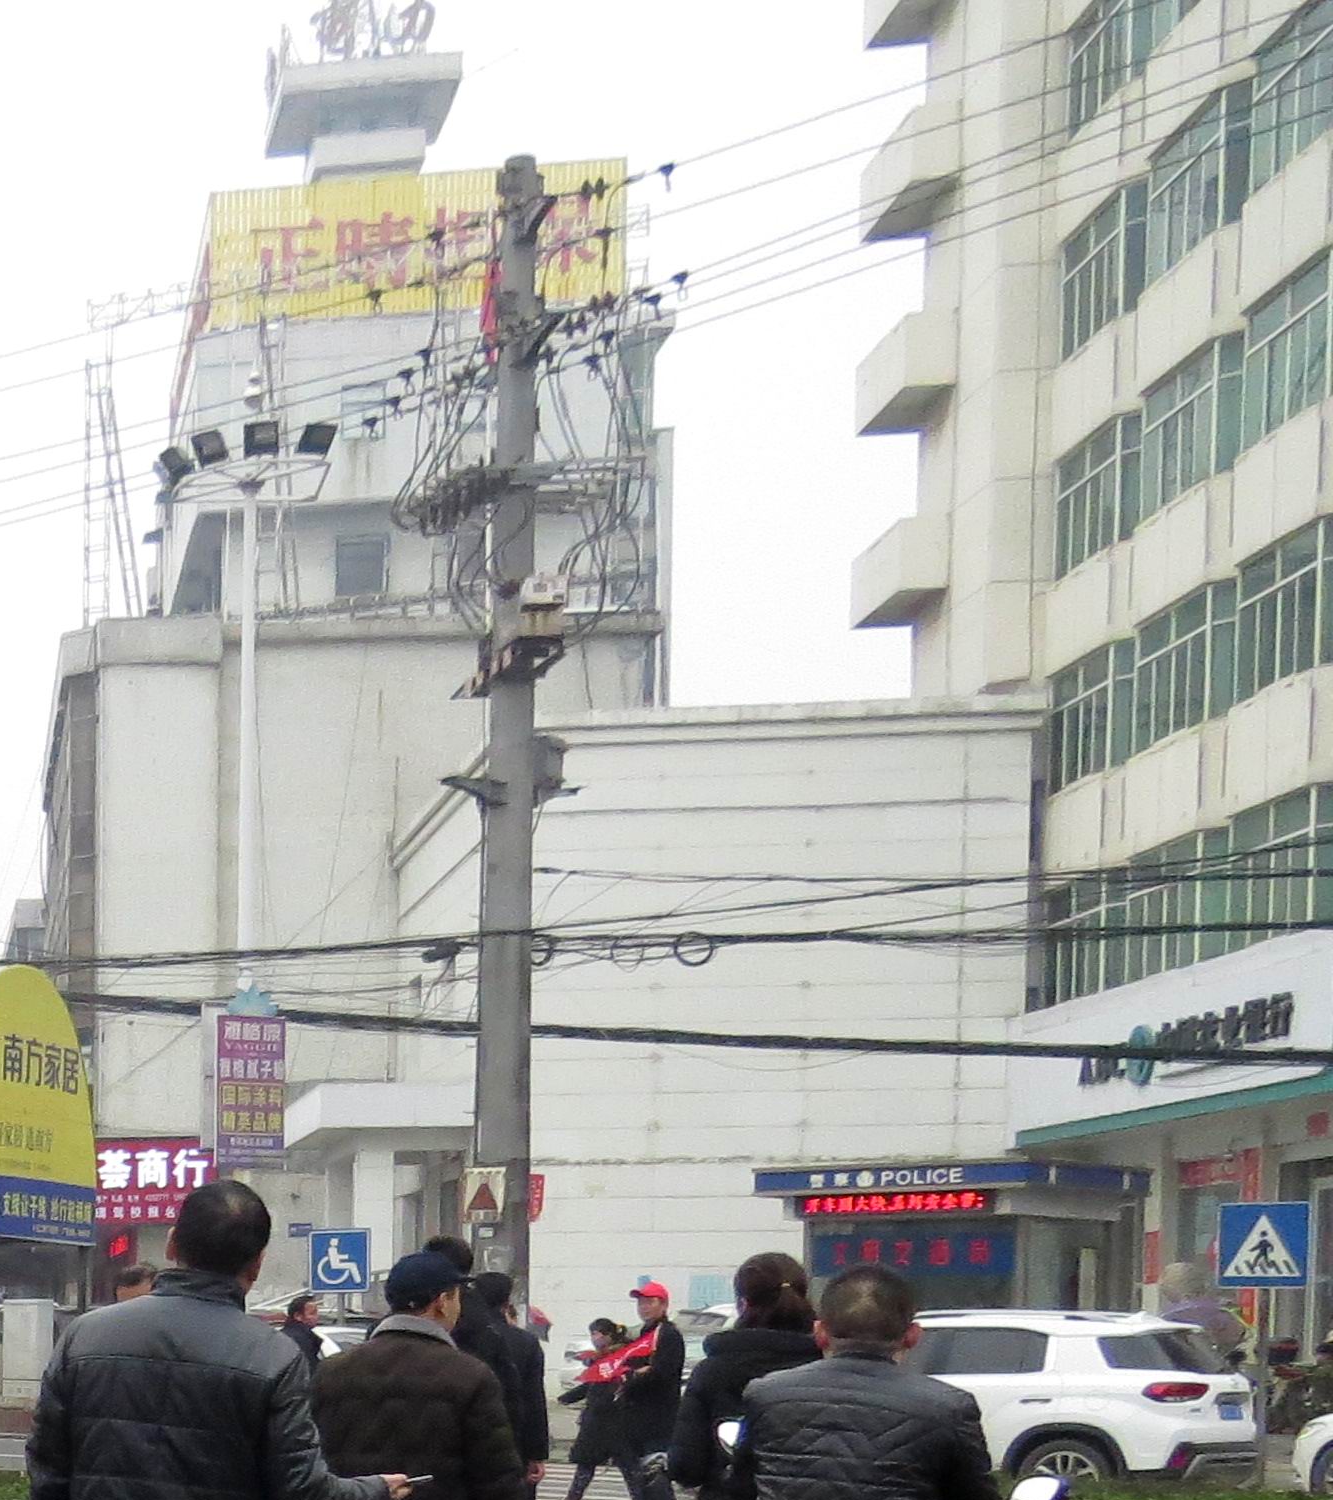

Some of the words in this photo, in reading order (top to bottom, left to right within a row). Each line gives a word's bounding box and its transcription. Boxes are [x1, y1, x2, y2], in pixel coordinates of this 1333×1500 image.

[3, 1034, 79, 1095] 南方家居
[880, 1167, 963, 1186] POLICE
